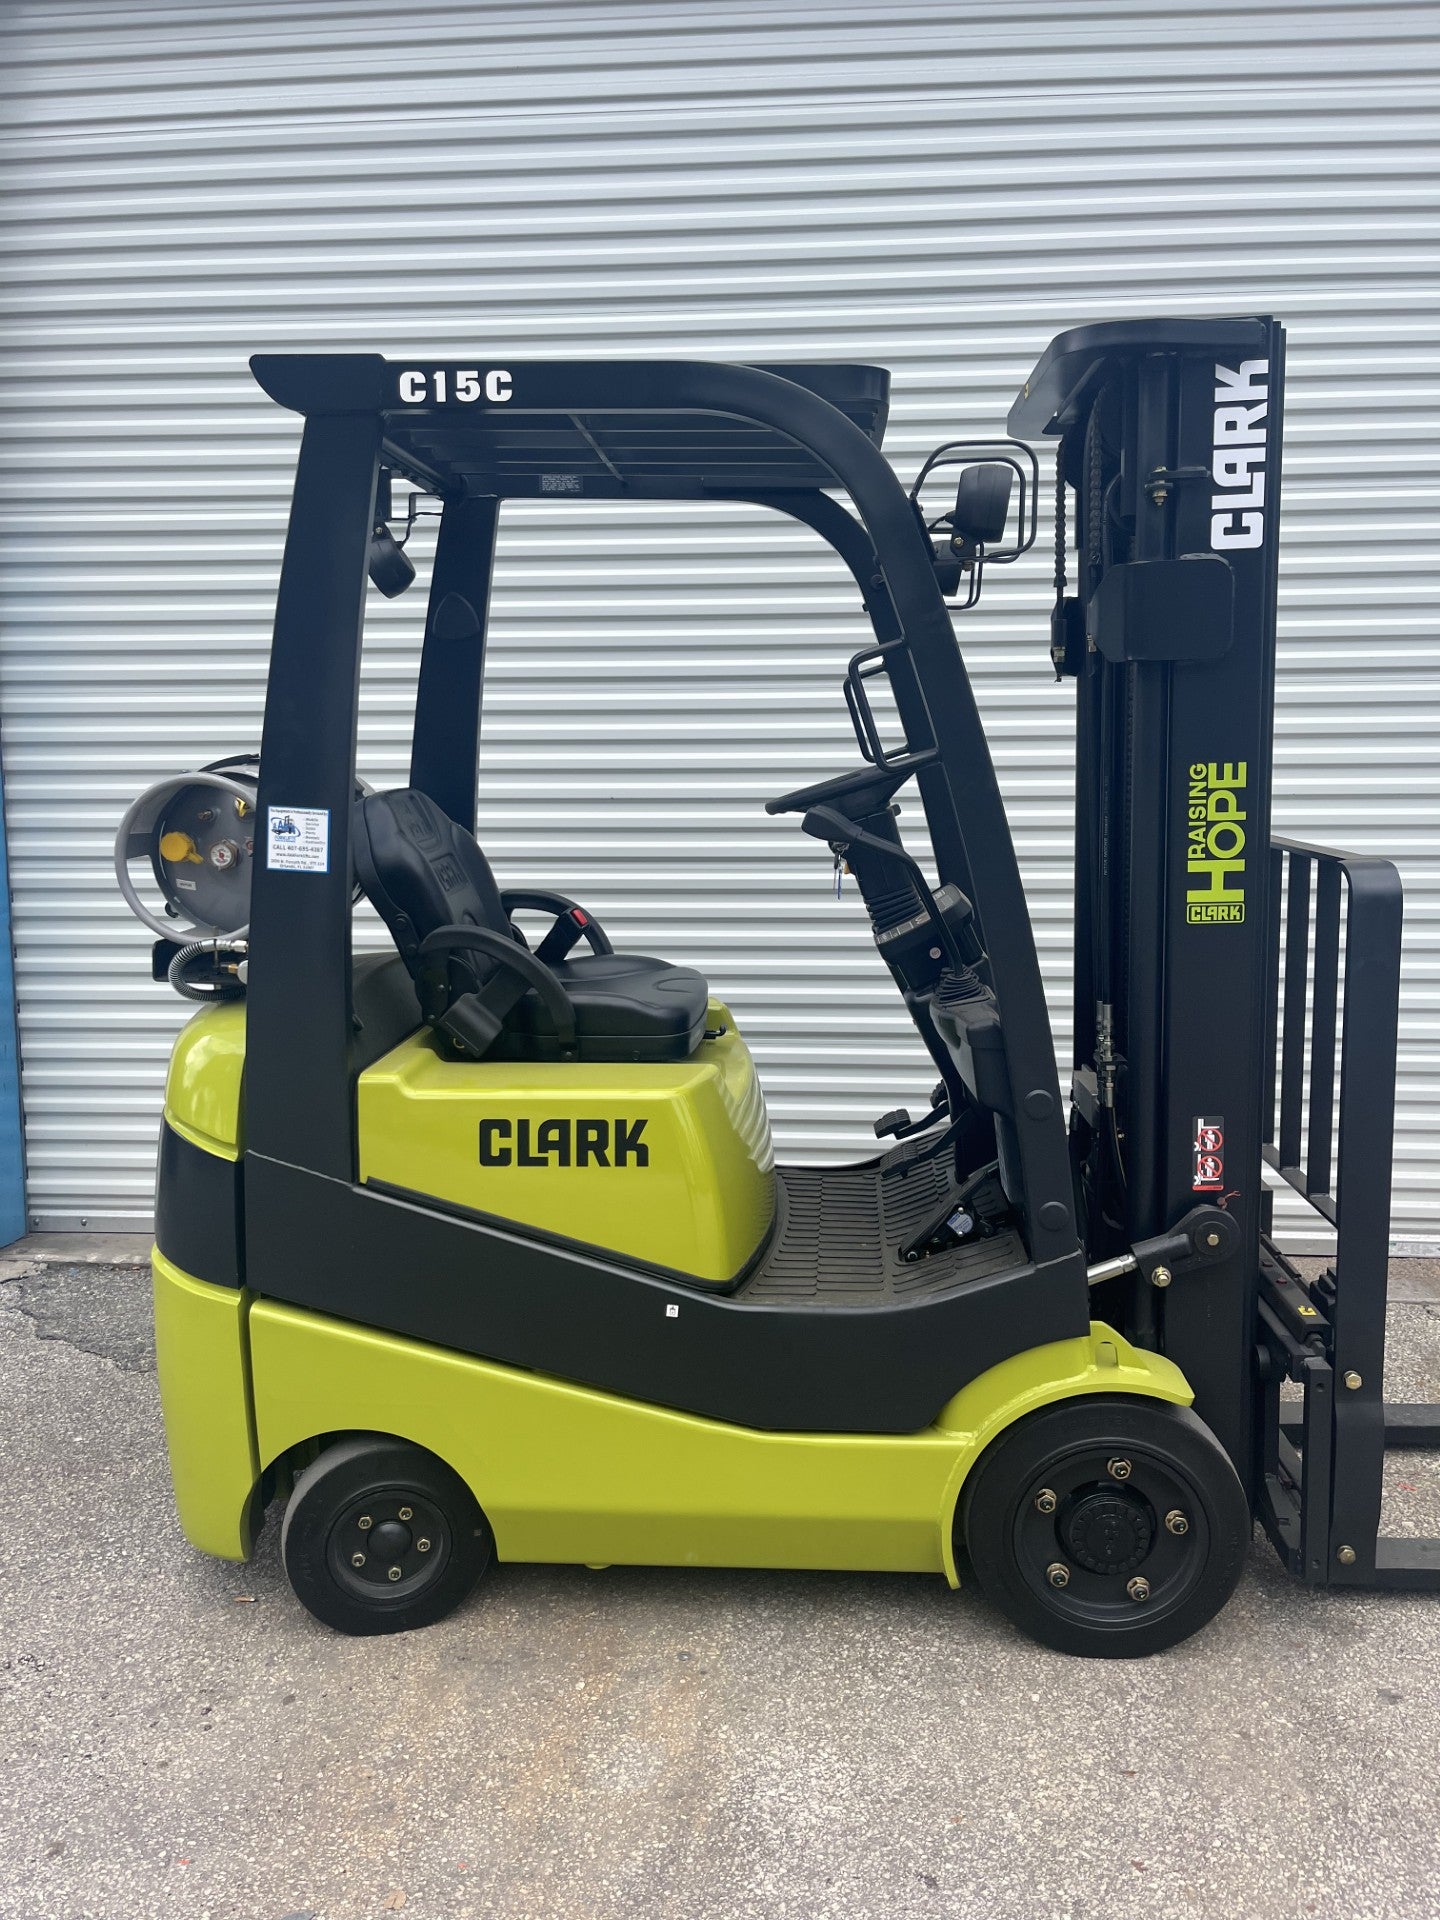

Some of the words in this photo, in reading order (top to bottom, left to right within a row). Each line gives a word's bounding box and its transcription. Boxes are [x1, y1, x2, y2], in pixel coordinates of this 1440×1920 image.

[400, 370, 513, 402] C15C
[1210, 359, 1269, 550] CLARK
[1187, 762, 1247, 903] HOPE
[1188, 763, 1207, 859] RAISING
[1190, 905, 1241, 921] CLARK
[479, 1119, 649, 1167] CLARK
